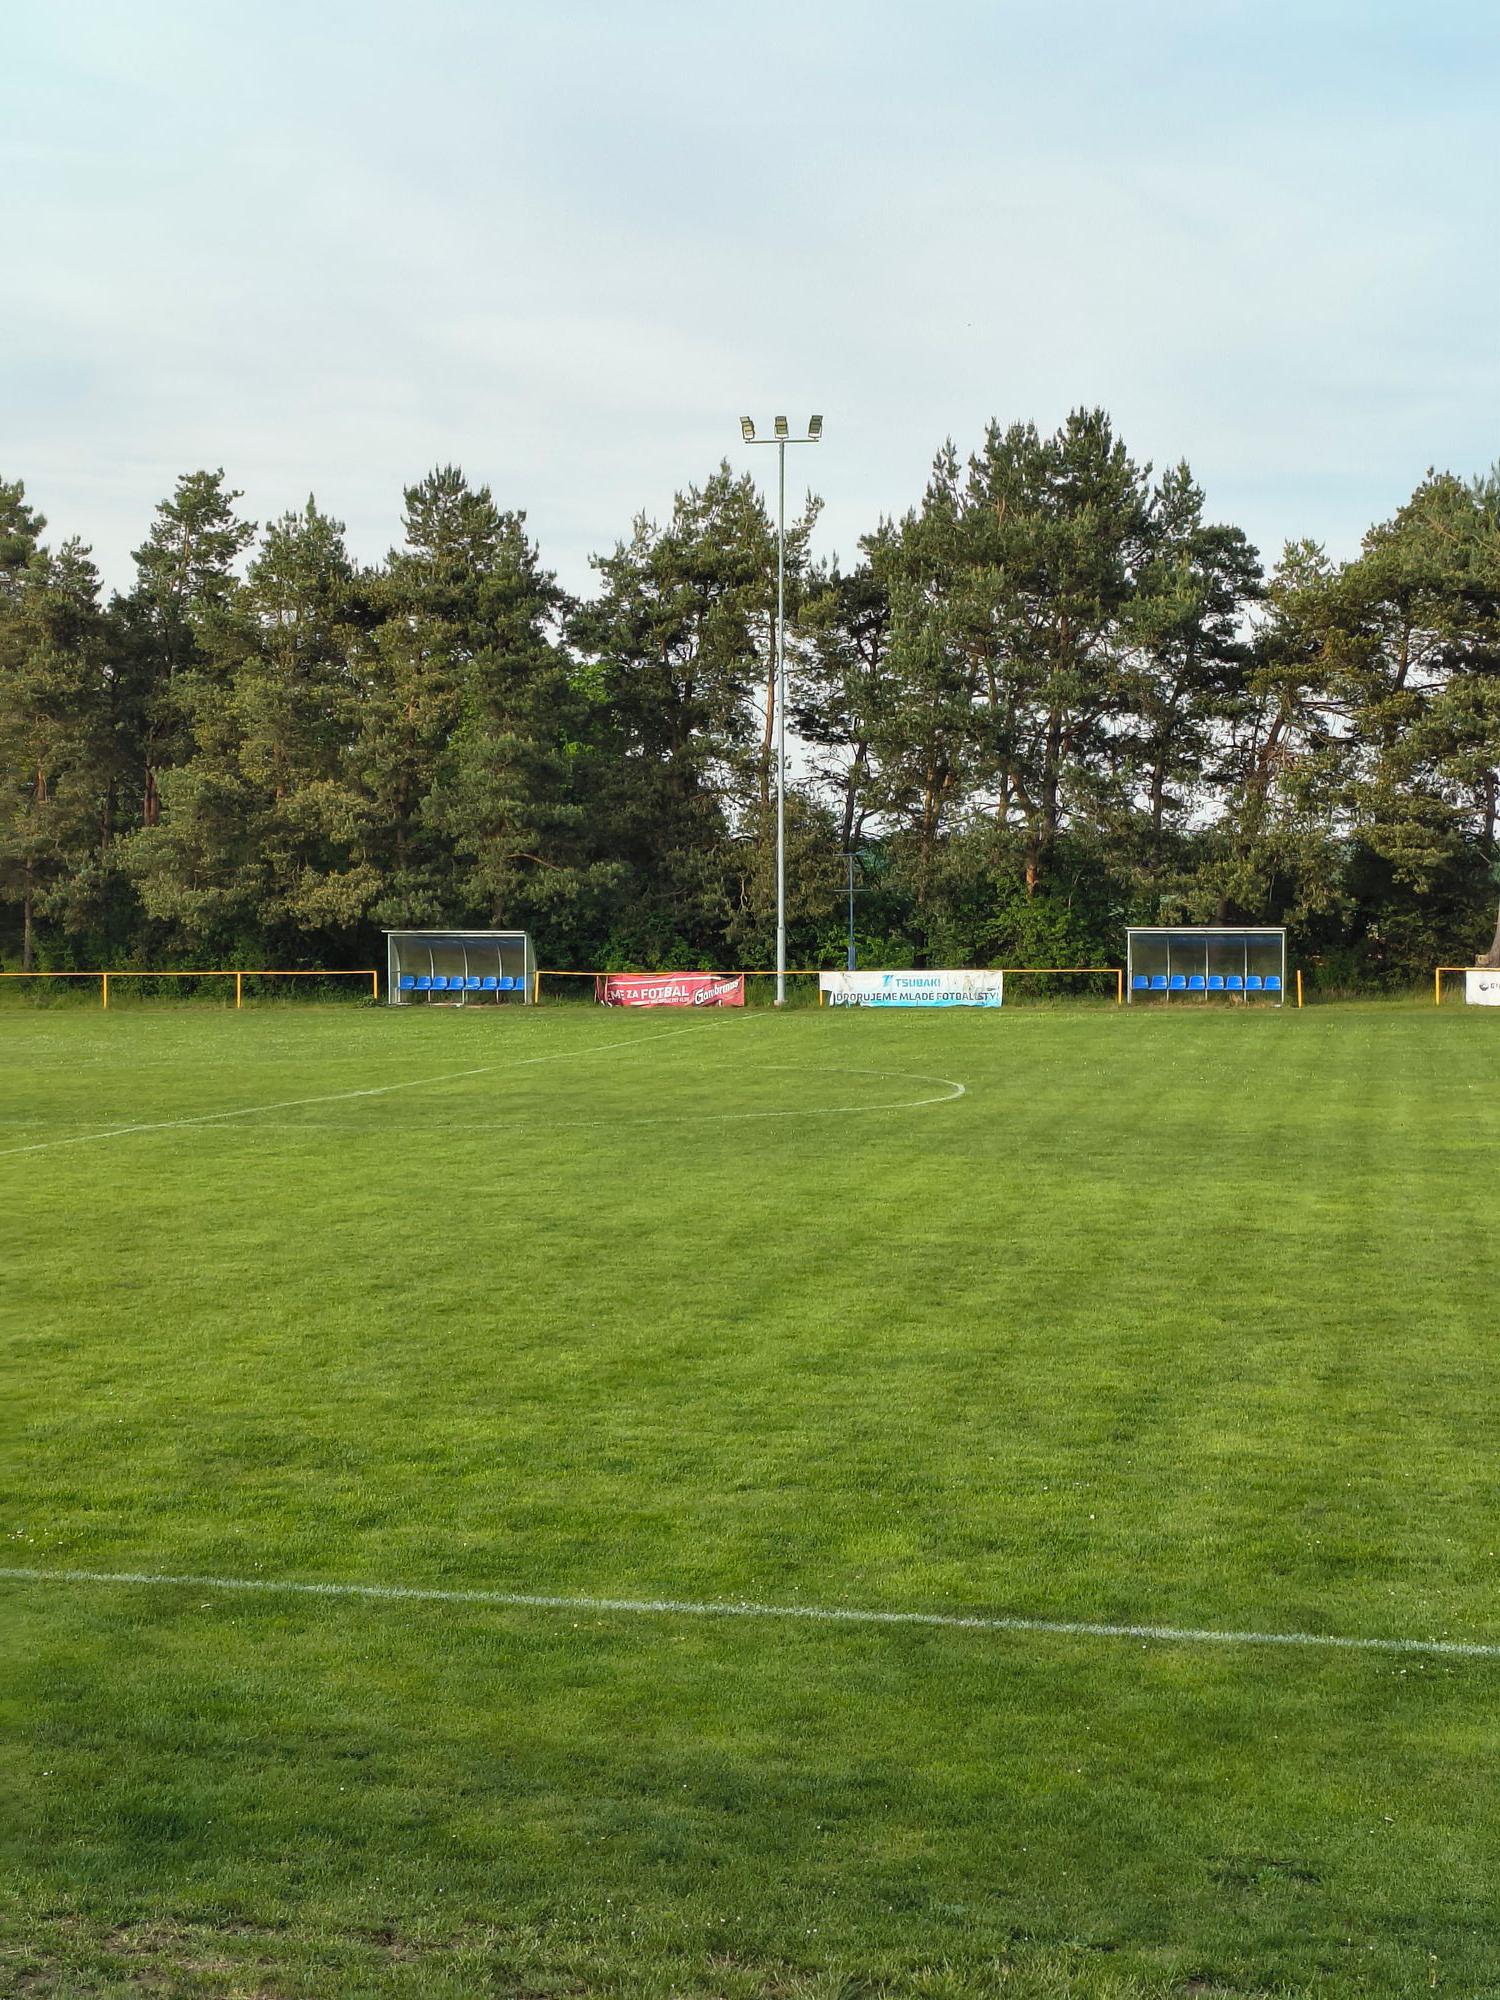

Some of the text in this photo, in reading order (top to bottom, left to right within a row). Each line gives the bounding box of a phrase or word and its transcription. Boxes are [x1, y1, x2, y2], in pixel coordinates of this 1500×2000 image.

[895, 978, 941, 988] TSUBAKI
[626, 989, 639, 999] ZA
[640, 985, 690, 1000] FOTBAL
[694, 979, 739, 1005] Gambrinus
